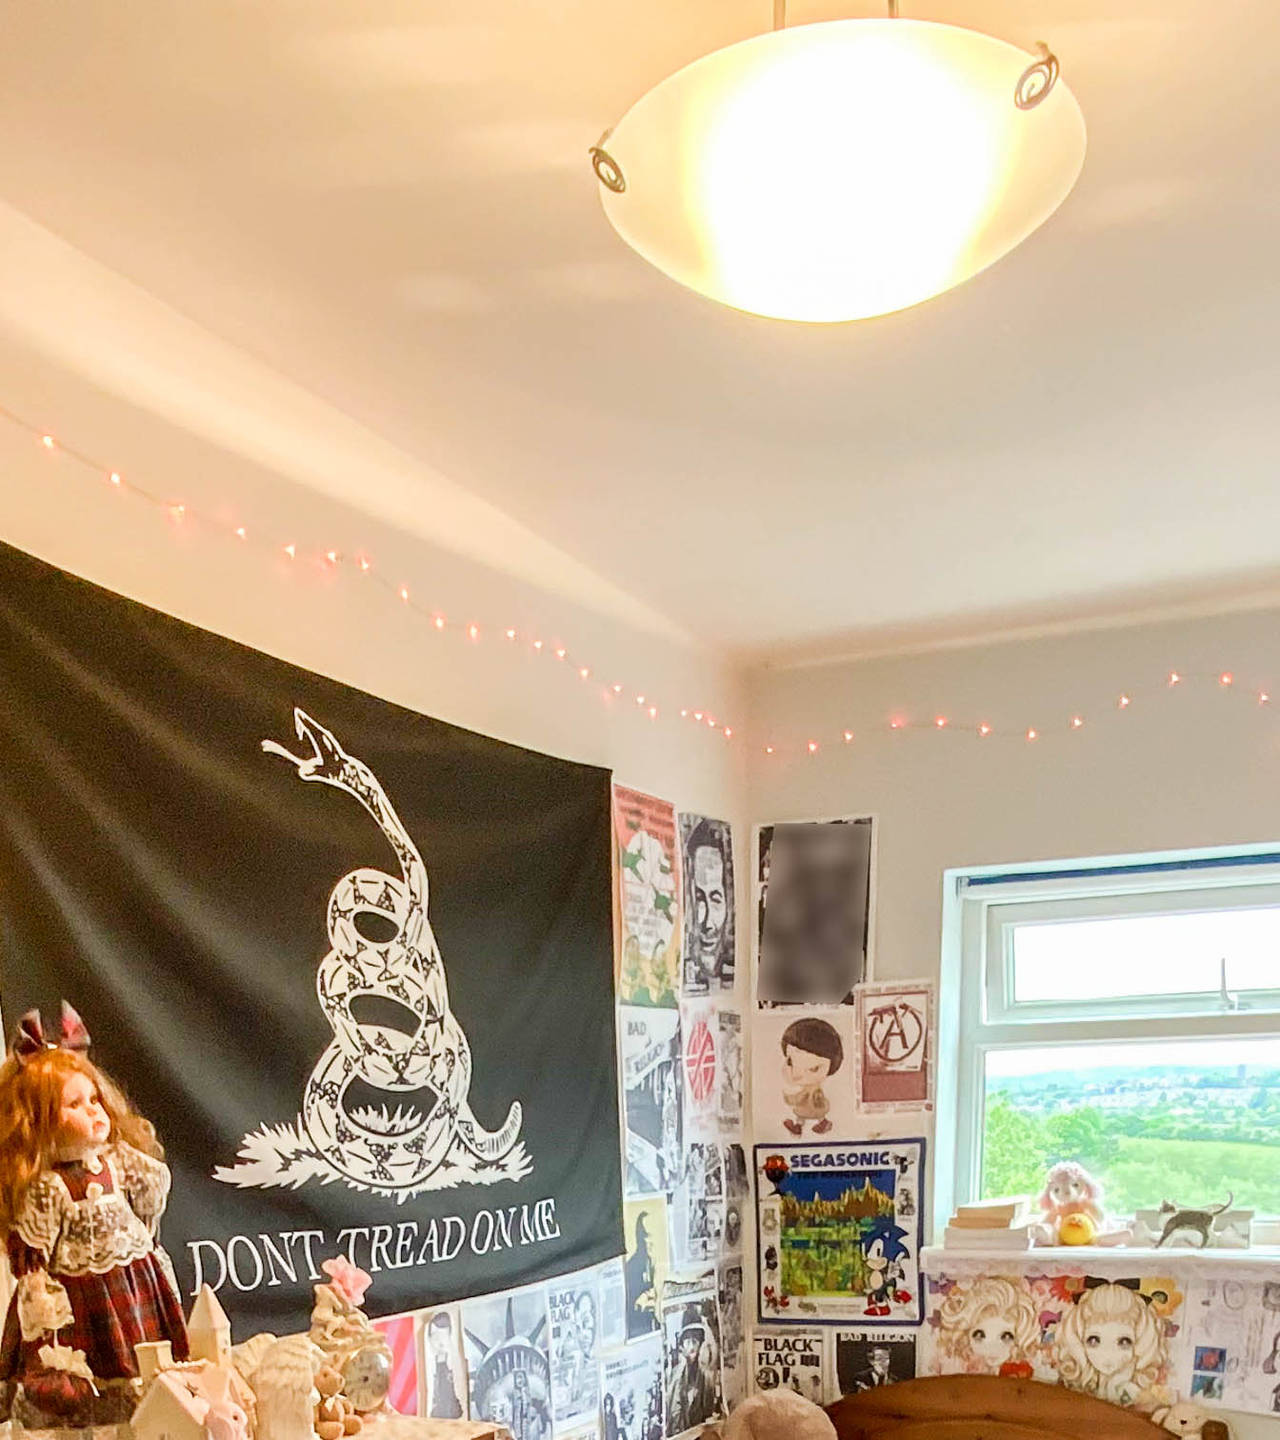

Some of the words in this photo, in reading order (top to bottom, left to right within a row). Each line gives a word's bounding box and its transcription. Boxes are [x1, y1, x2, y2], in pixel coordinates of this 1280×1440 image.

[627, 1021, 647, 1036] BAD
[790, 1151, 890, 1168] SEGASONIC
[186, 1229, 325, 1297] DONT
[336, 1215, 467, 1273] TREAD
[470, 1206, 518, 1256] ON
[519, 1198, 562, 1245] ME
[549, 1290, 576, 1309] BLACK
[550, 1306, 571, 1324] FLAG
[763, 1338, 814, 1352] BLACK
[758, 1352, 796, 1366] FLAG
